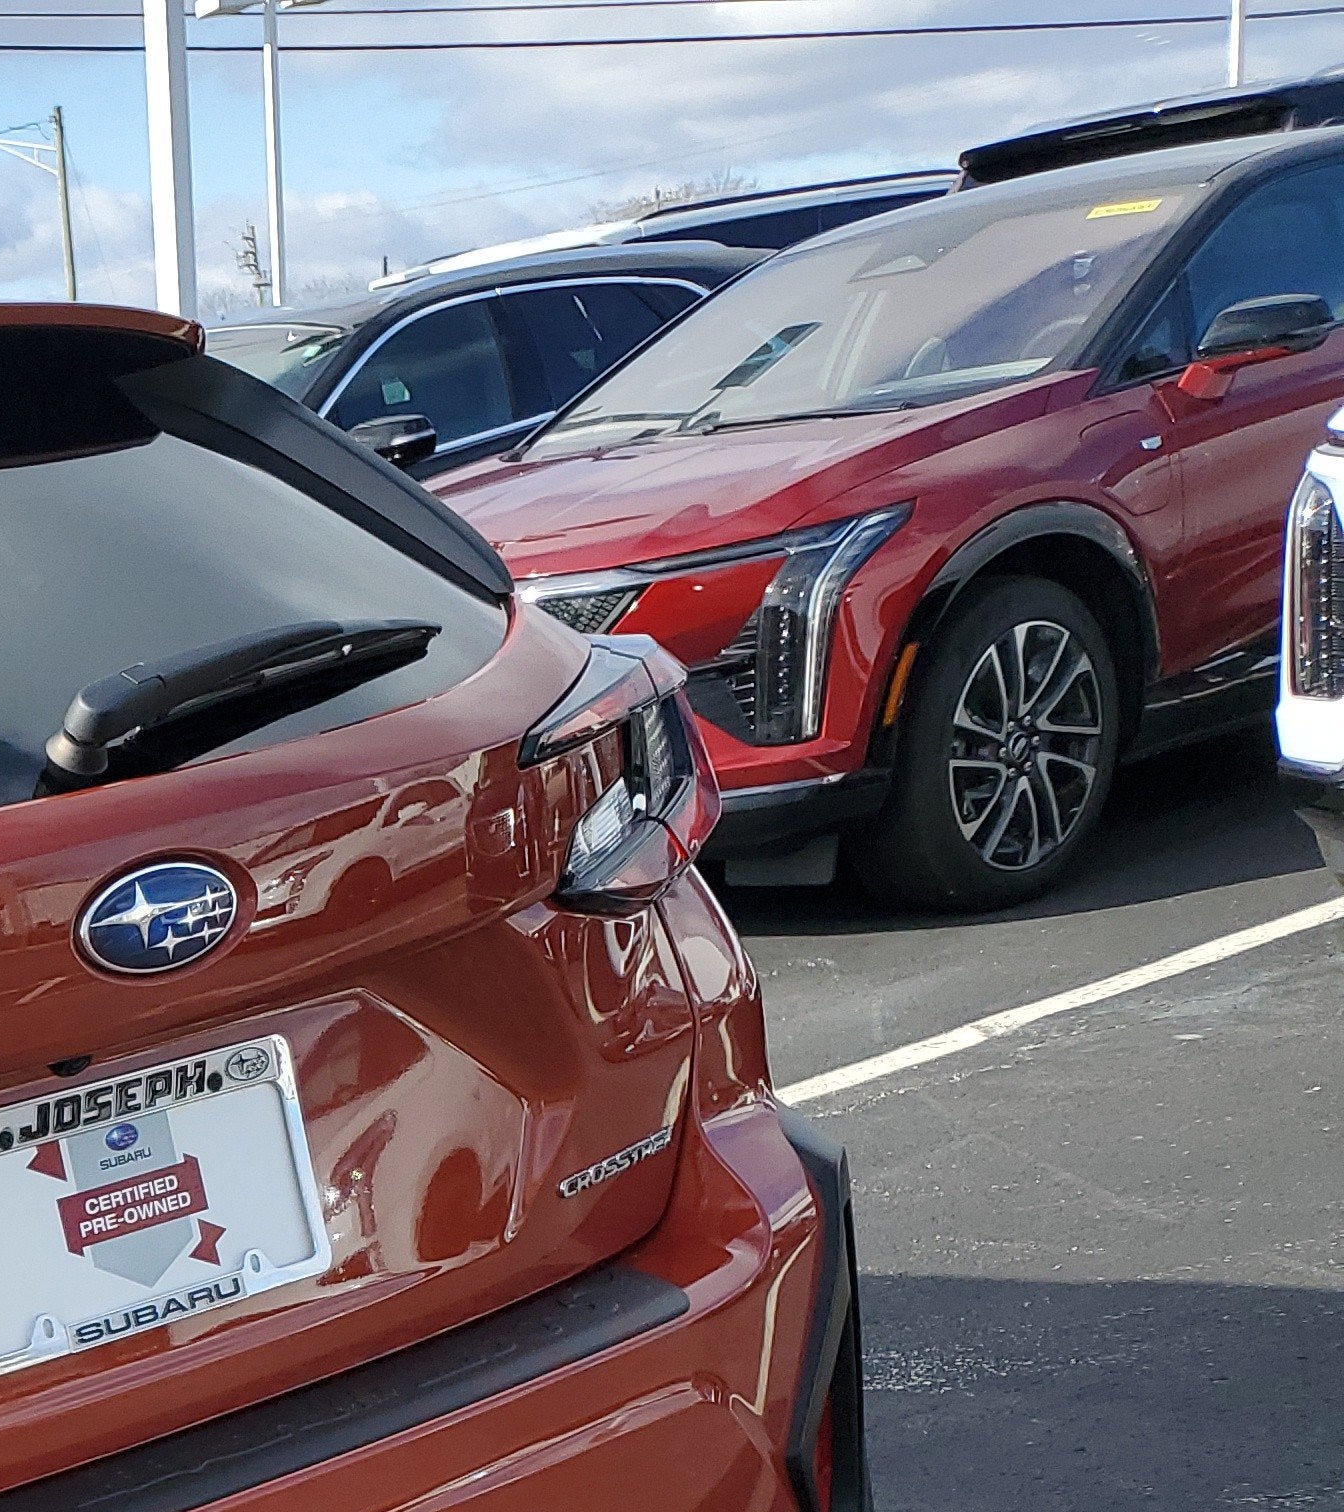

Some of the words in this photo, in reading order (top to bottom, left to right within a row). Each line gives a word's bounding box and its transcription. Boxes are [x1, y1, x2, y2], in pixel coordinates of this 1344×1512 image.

[18, 1059, 208, 1144] JOSEPH
[99, 1147, 153, 1171] SUBARU
[79, 1191, 192, 1238] PRE-OWNED
[85, 1174, 179, 1216] CERTIFIED
[75, 1277, 242, 1345] SUBARU
